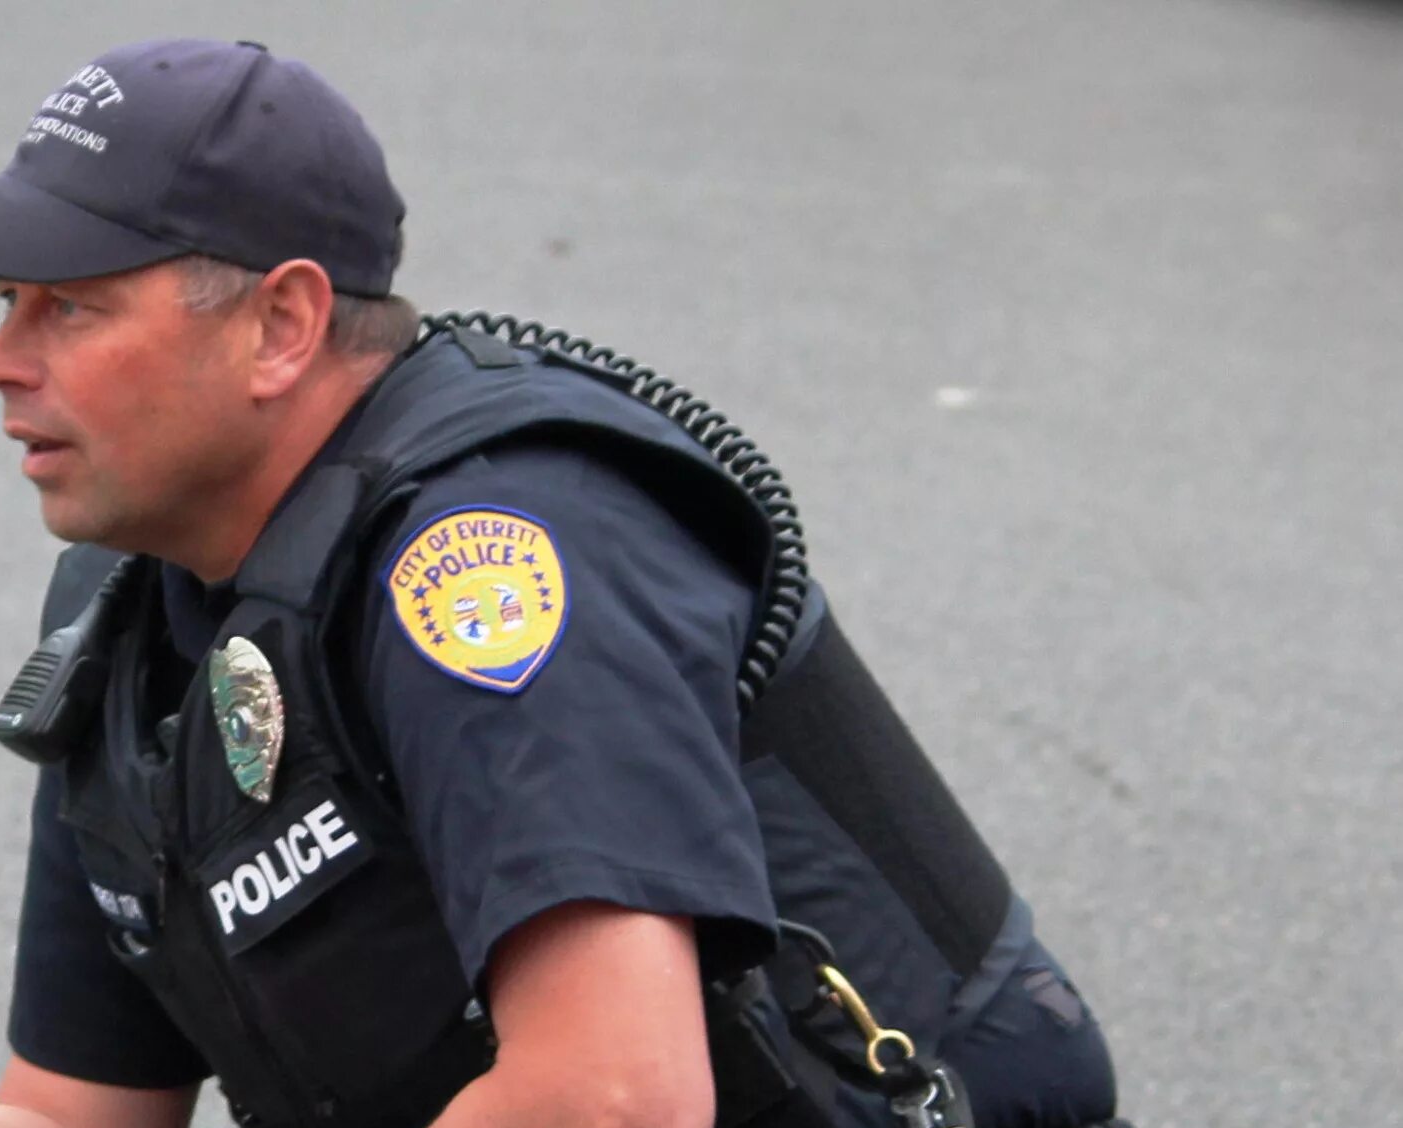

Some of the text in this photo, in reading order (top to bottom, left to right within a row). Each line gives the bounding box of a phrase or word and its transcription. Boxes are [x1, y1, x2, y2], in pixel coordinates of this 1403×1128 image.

[395, 519, 539, 588] CITY OF EVERETT
[423, 542, 515, 589] POLICE
[209, 800, 359, 935] POLICE
